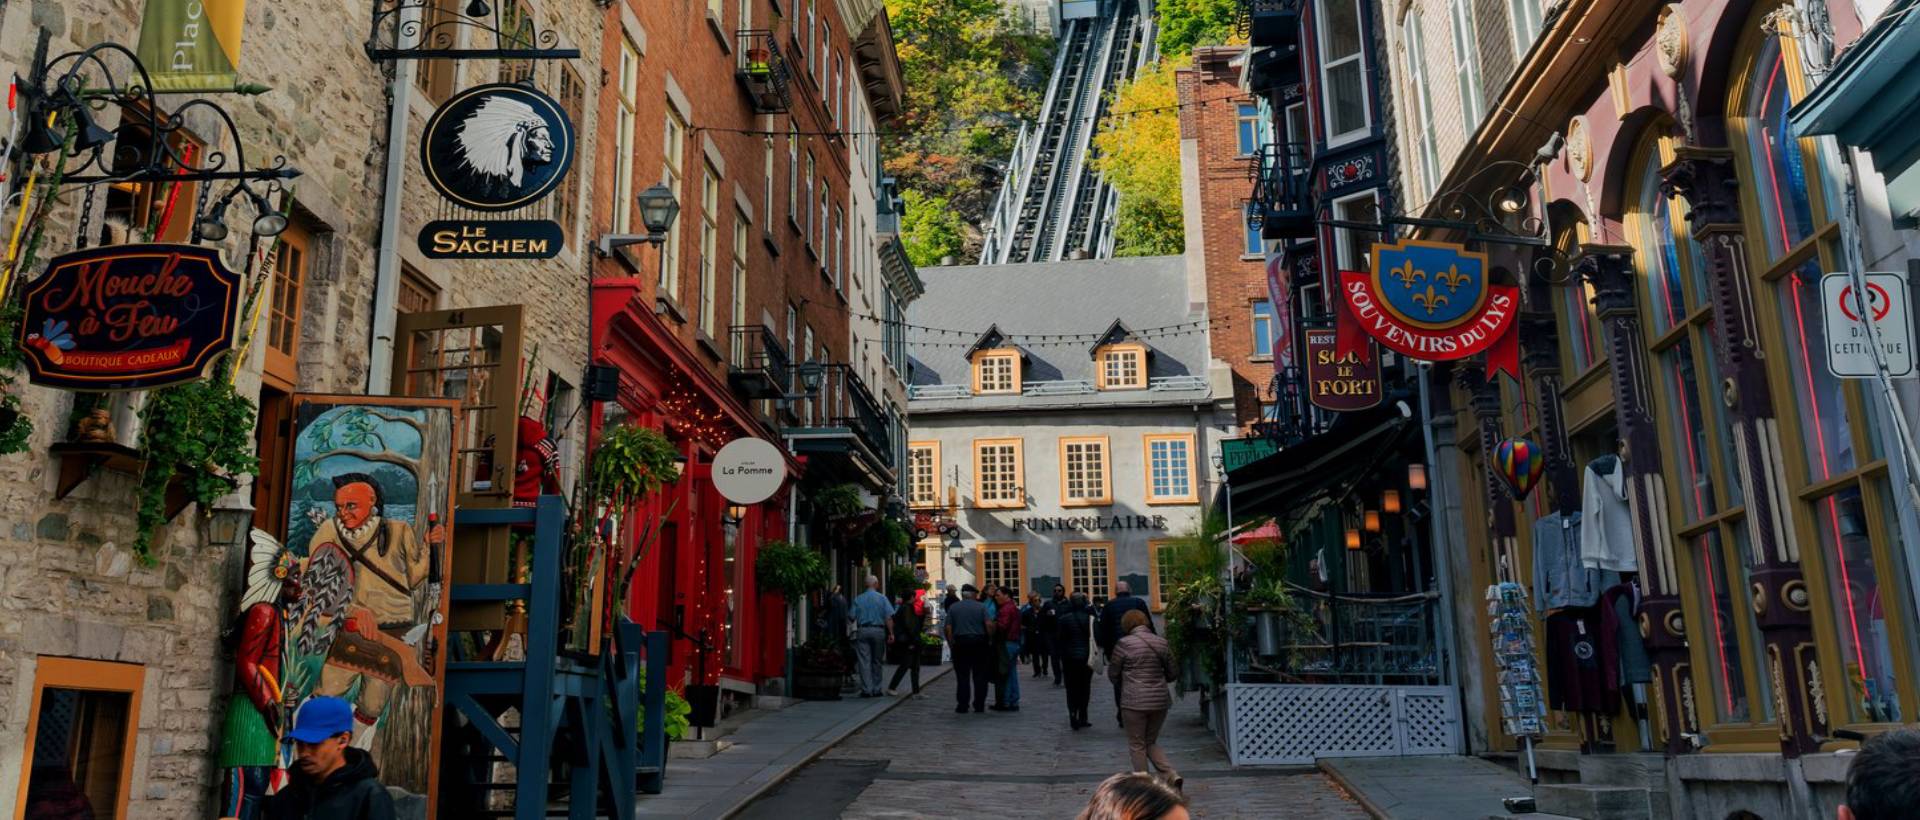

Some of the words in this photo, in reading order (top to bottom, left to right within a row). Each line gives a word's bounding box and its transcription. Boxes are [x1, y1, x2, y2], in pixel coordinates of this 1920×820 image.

[462, 226, 486, 238] LE
[433, 231, 548, 253] SACHEM
[43, 252, 192, 312] Mouche
[79, 308, 99, 334] à
[1348, 281, 1457, 352] SOUVENIRS
[1459, 325, 1486, 348] DU
[1487, 294, 1511, 331] LYS
[66, 354, 121, 367] BOUTIQUE
[127, 349, 179, 366] CADEAUX
[1337, 366, 1353, 377] LE
[1318, 380, 1376, 395] FORT
[722, 467, 735, 475] La
[737, 466, 773, 475] Pomme
[1012, 514, 1168, 532] FUNICULAIRE
